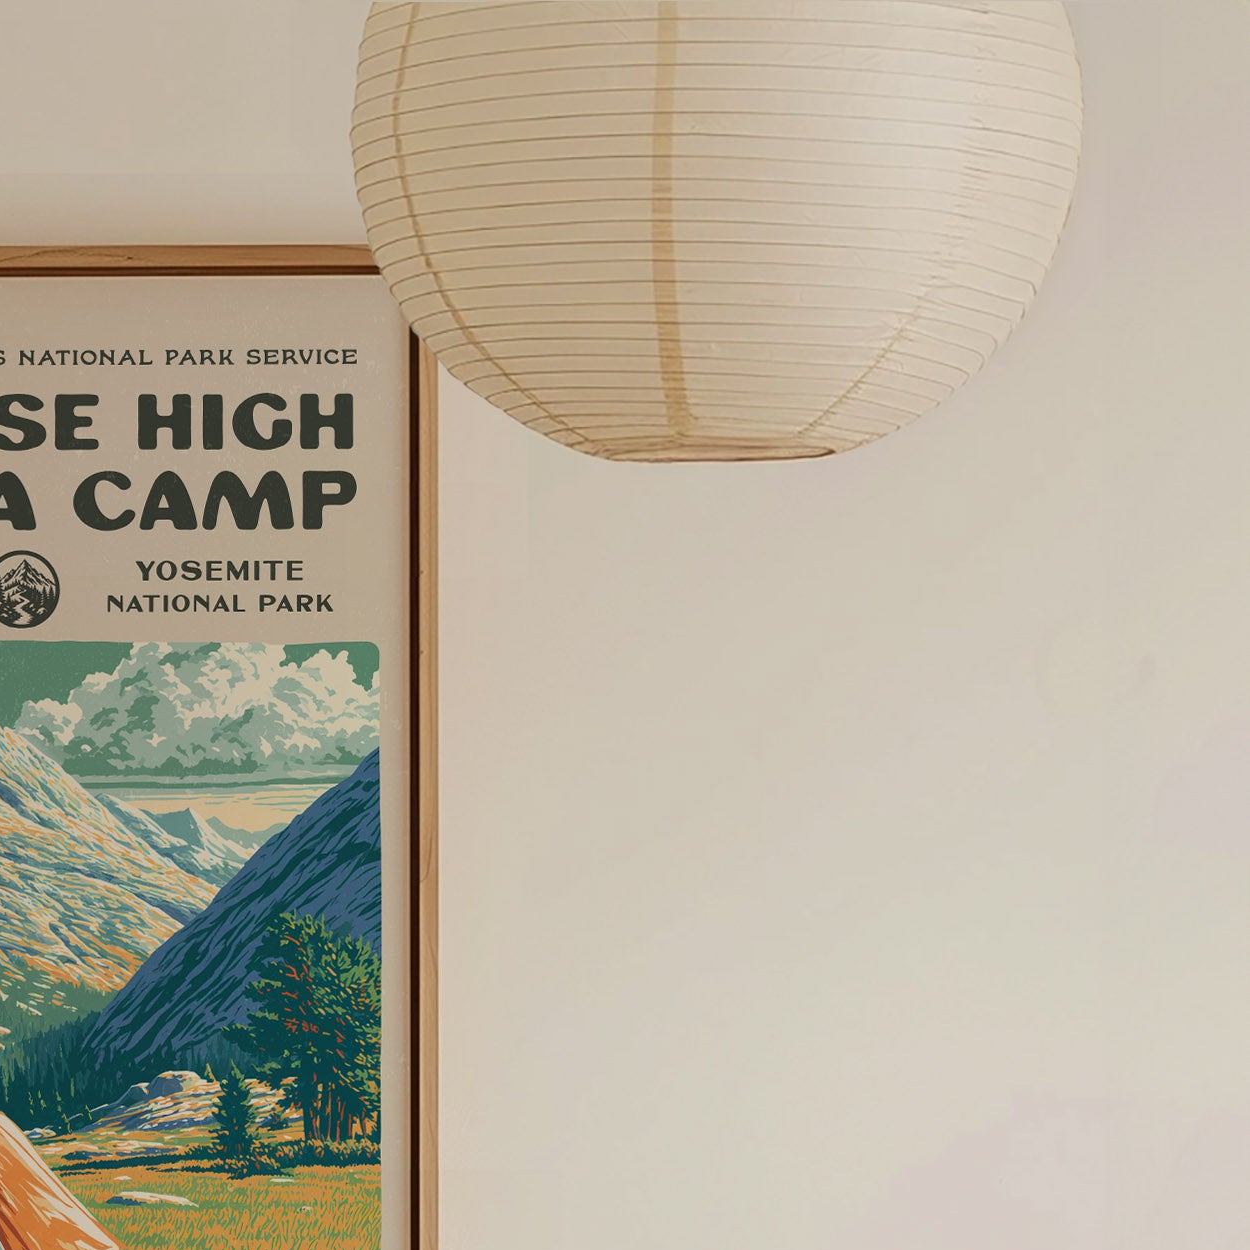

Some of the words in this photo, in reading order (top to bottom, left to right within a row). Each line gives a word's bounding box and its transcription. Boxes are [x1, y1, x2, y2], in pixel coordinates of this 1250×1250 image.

[19, 349, 153, 366] NATIONAL
[166, 349, 235, 366] PARK
[247, 348, 358, 366] SERVICE
[137, 392, 354, 451] HIGH
[72, 470, 358, 532] CAMP
[135, 559, 304, 582] YOSEMITE
[107, 594, 246, 613] NATIONAL
[258, 593, 334, 613] PARK
